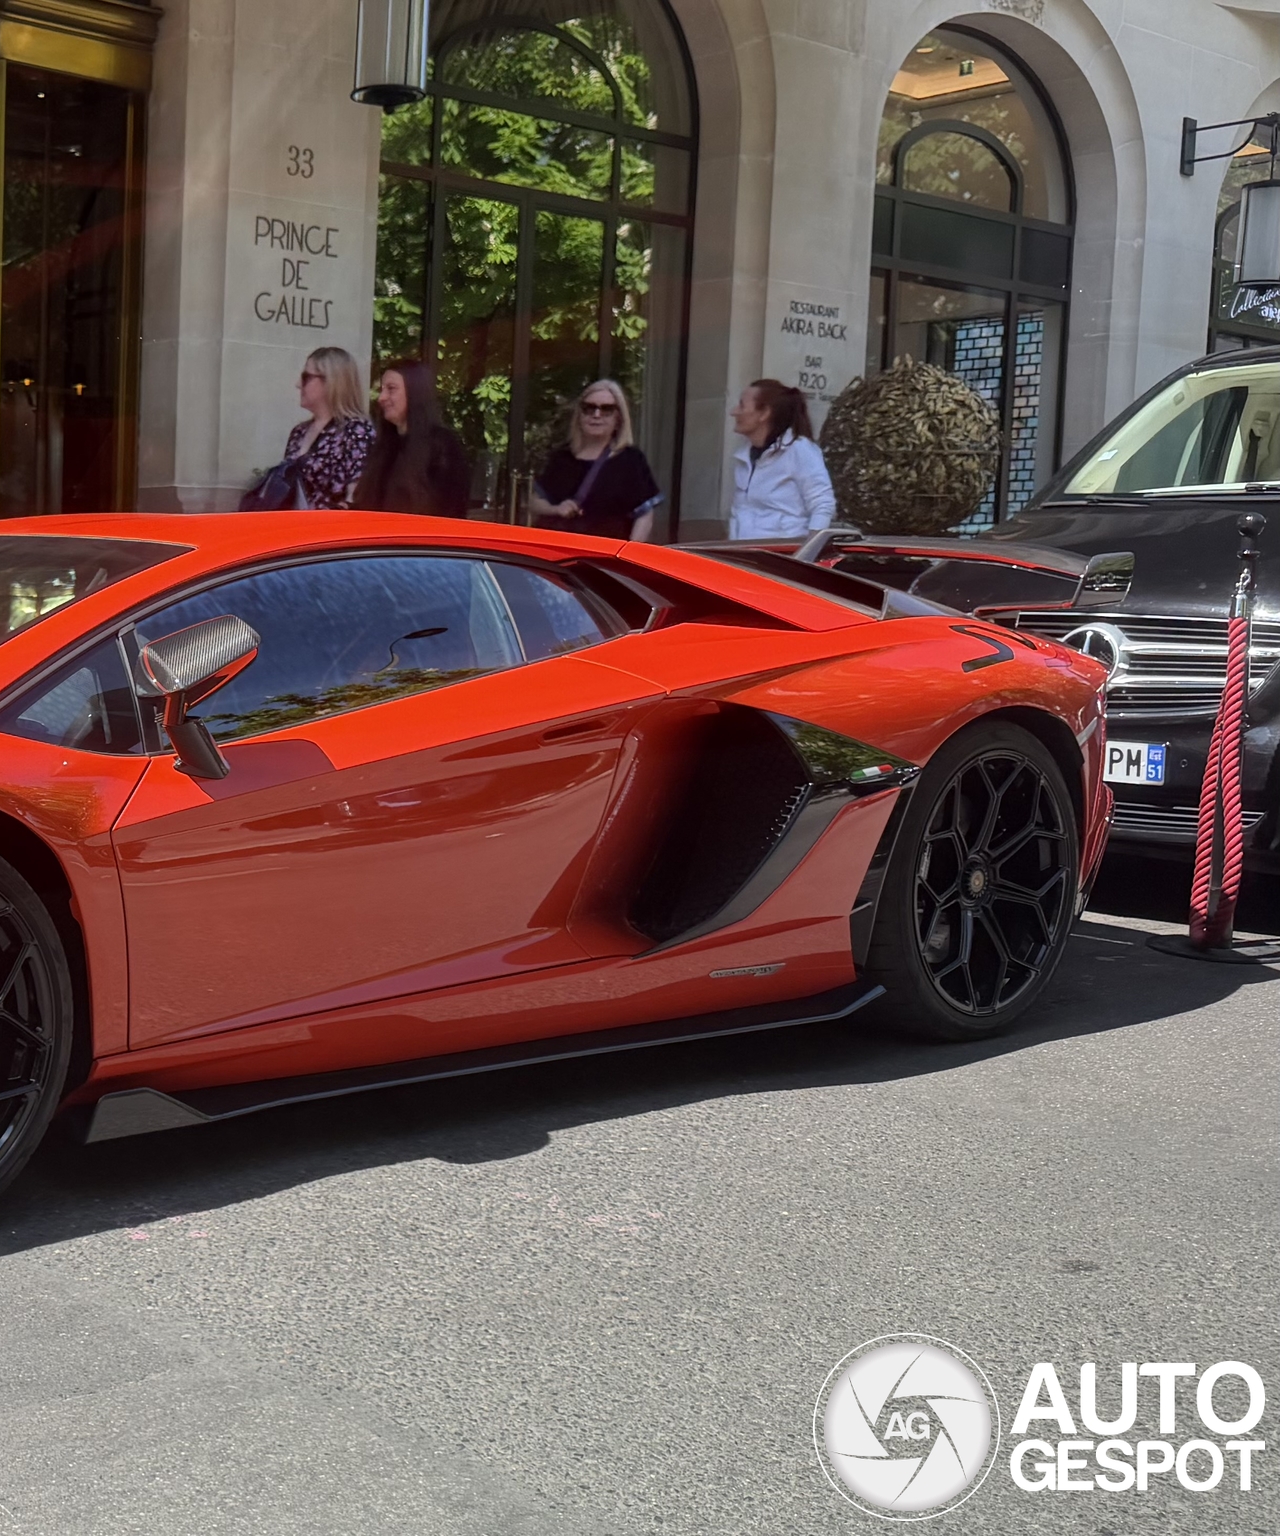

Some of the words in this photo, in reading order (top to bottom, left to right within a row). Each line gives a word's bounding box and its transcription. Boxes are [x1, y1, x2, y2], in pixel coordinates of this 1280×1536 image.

[286, 145, 315, 179] 33
[254, 216, 339, 258] PRINCE
[281, 257, 310, 290] DE
[254, 292, 333, 330] GALLES
[790, 301, 839, 318] RESTAURANT
[818, 322, 847, 341] BACK
[805, 355, 822, 368] BAR
[1109, 748, 1141, 777] PM
[1148, 764, 1162, 779] 51
